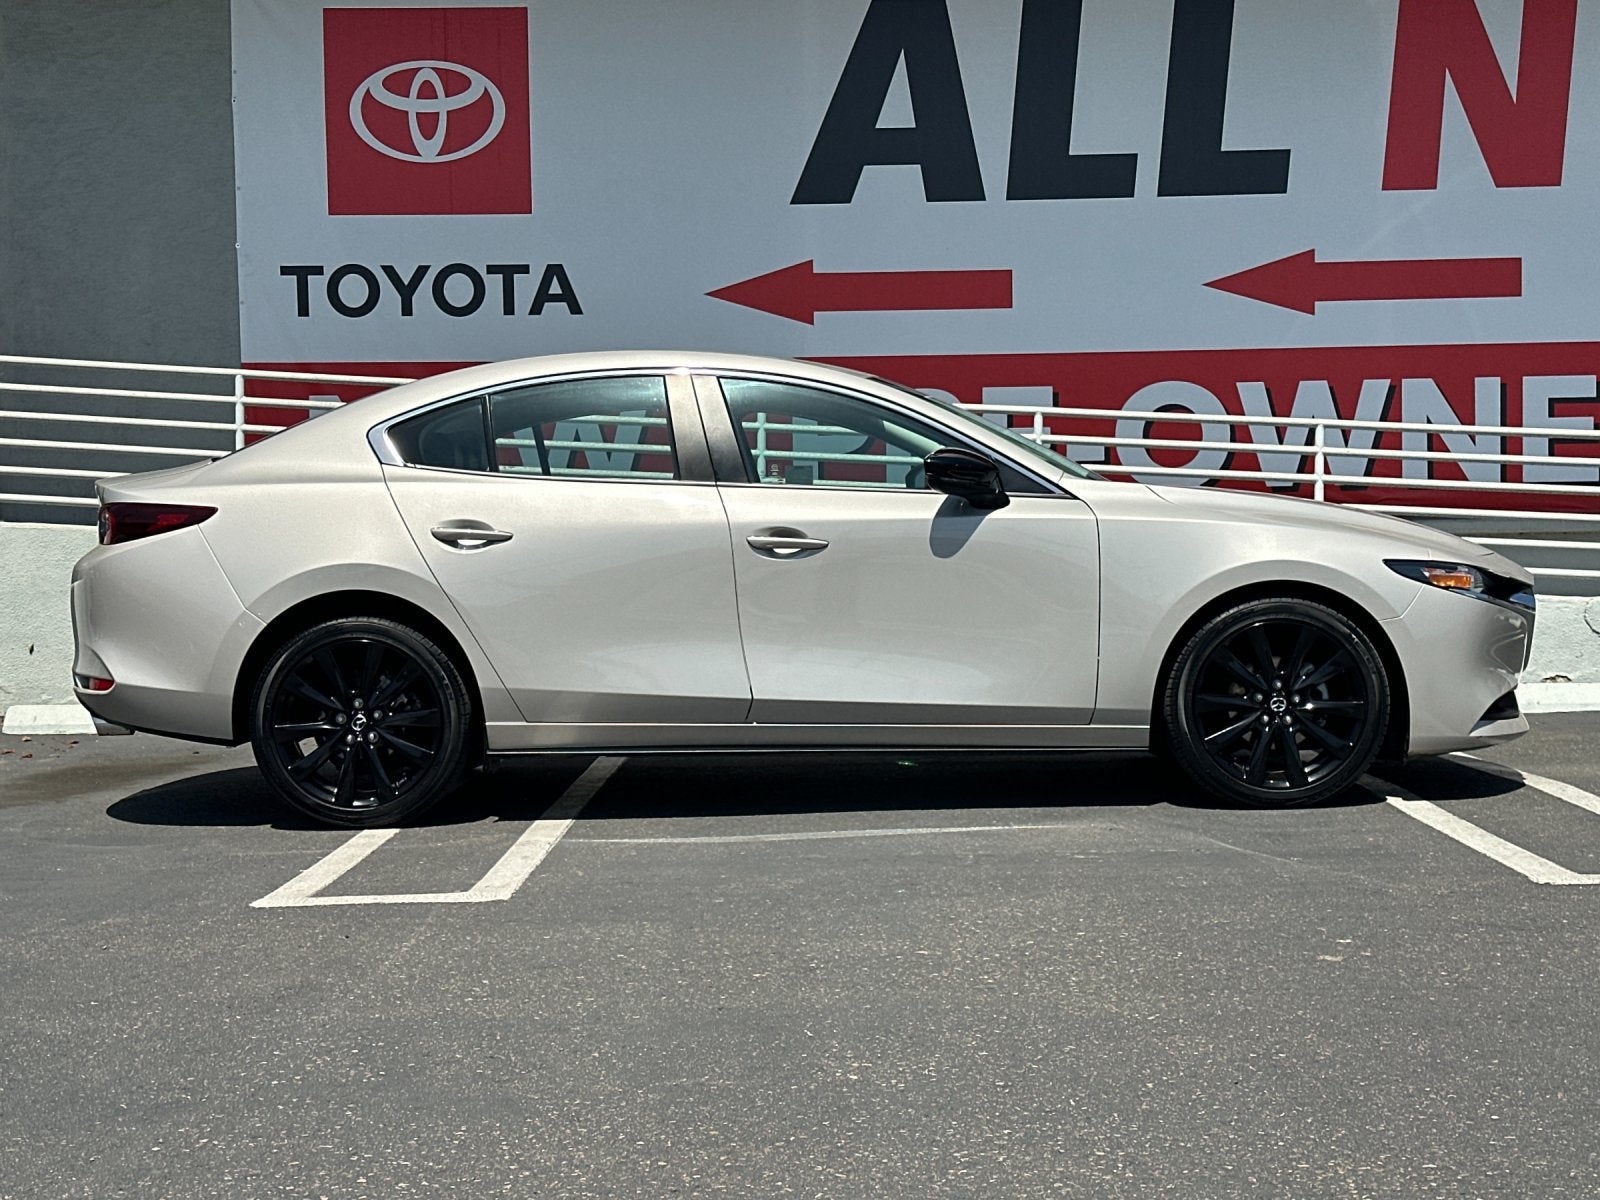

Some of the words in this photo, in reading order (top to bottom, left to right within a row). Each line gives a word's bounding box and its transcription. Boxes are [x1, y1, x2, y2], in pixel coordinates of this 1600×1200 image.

[790, 0, 1291, 204] ALL
[1383, 0, 1575, 189] N
[280, 263, 583, 317] TOYOTA
